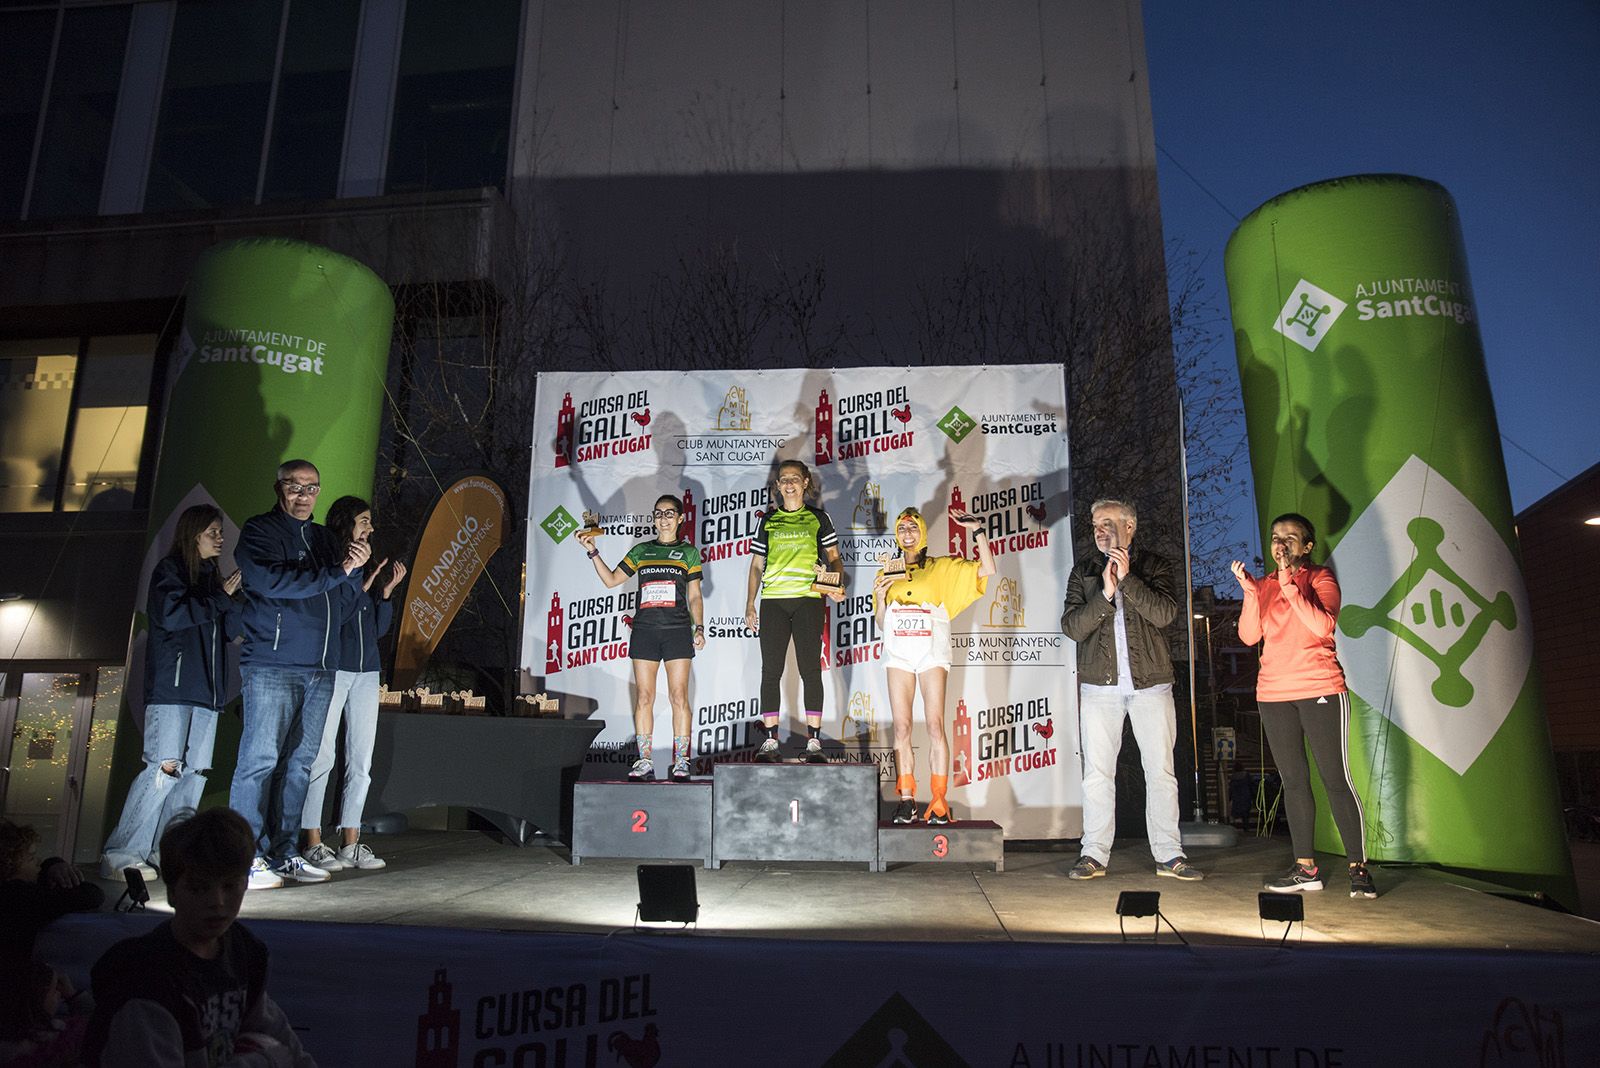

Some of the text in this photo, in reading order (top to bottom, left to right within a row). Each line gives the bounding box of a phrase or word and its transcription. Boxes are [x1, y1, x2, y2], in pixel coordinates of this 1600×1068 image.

[1356, 294, 1471, 324] SantCuga
[203, 329, 327, 356] AJUNTAMENT DE
[199, 344, 324, 375] SantCugat
[581, 390, 650, 418] CURSA DEL
[838, 386, 910, 416] CURSA DEL
[579, 412, 632, 445] GALL
[838, 409, 894, 443] GALL
[981, 413, 1056, 422] AJUNTAMENT DE
[981, 422, 1057, 436] SantCugat
[577, 434, 652, 463] SANT CUGAT
[677, 438, 786, 450] CLUB MUNTANYENC
[696, 451, 765, 462] SANT CUGAT
[838, 432, 914, 461] SANT CUGAT
[703, 486, 774, 516] CURSA DEL
[972, 482, 1044, 514] CURSA DEL
[602, 524, 658, 538] ntCugat
[701, 511, 756, 545] GALL
[422, 515, 479, 596] FUNDACIÓ
[700, 542, 733, 563] SANT
[841, 539, 898, 549] MUNTANY
[973, 531, 1049, 560] SNT CUGAT
[434, 518, 494, 604] CLUB MUNTANYENC
[640, 567, 683, 576] CERDANYOLA
[441, 555, 483, 612] SANT CUGAT
[569, 595, 614, 620] CURSA
[837, 594, 873, 618] CURS
[568, 616, 622, 650] GALL
[708, 626, 761, 638] SantCu
[837, 615, 881, 648] GAL
[897, 618, 927, 630] 2071
[567, 642, 629, 669] SANT CUG
[836, 645, 870, 668] SANT
[968, 651, 1042, 662] SANT CUGAT
[978, 637, 1061, 649] MUNTANYENC
[699, 700, 745, 725] CURSA
[978, 698, 1052, 729] CURSA DEL
[697, 721, 755, 756] GALL
[978, 725, 1035, 761] GALL
[978, 748, 1057, 781] SANT CUGAT
[631, 810, 649, 833] 2
[788, 799, 800, 825] 1
[932, 834, 949, 858] 3
[475, 974, 657, 1039] CURSA DEL
